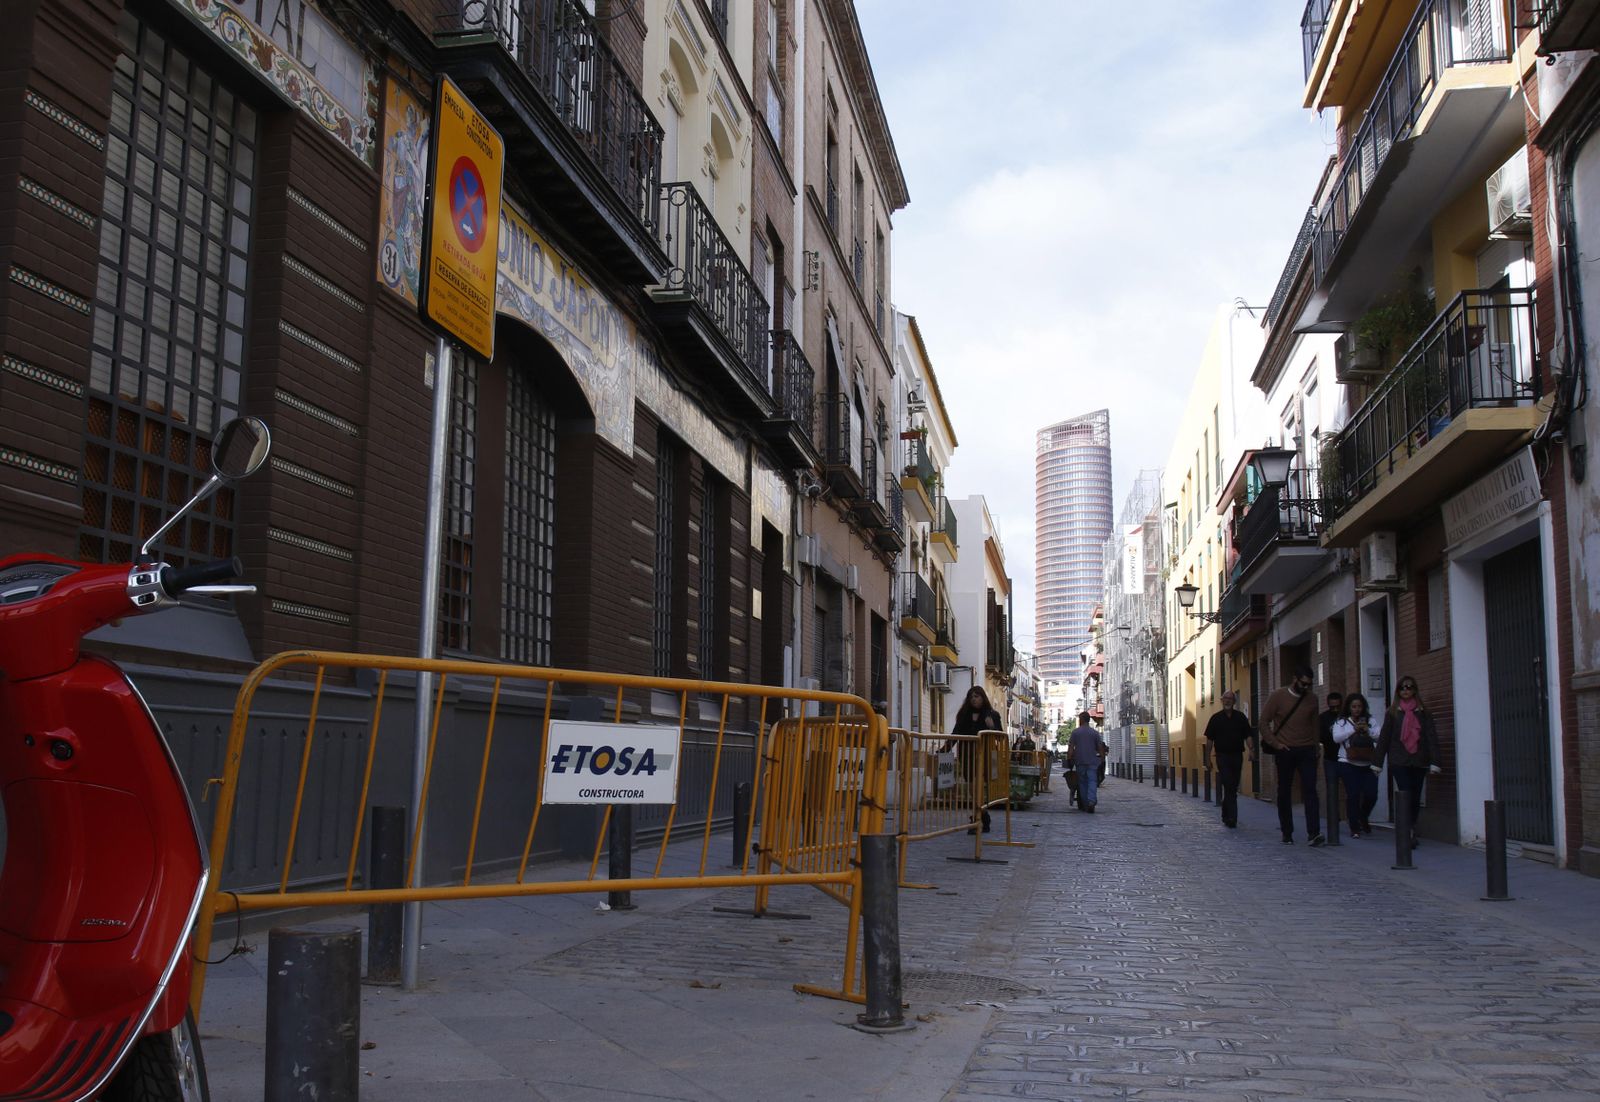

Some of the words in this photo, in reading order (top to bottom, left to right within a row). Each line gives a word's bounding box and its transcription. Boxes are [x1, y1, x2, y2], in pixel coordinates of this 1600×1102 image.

[471, 114, 490, 142] ETOSA
[384, 246, 398, 280] 31
[442, 240, 471, 271] RETIRADA
[471, 263, 487, 282] GRUA
[438, 264, 460, 287] RESERVA
[460, 279, 469, 293] DE
[468, 286, 487, 308] ESPACIO
[551, 744, 658, 776] ETOSA
[578, 788, 645, 799] CONSTRUCTORA
